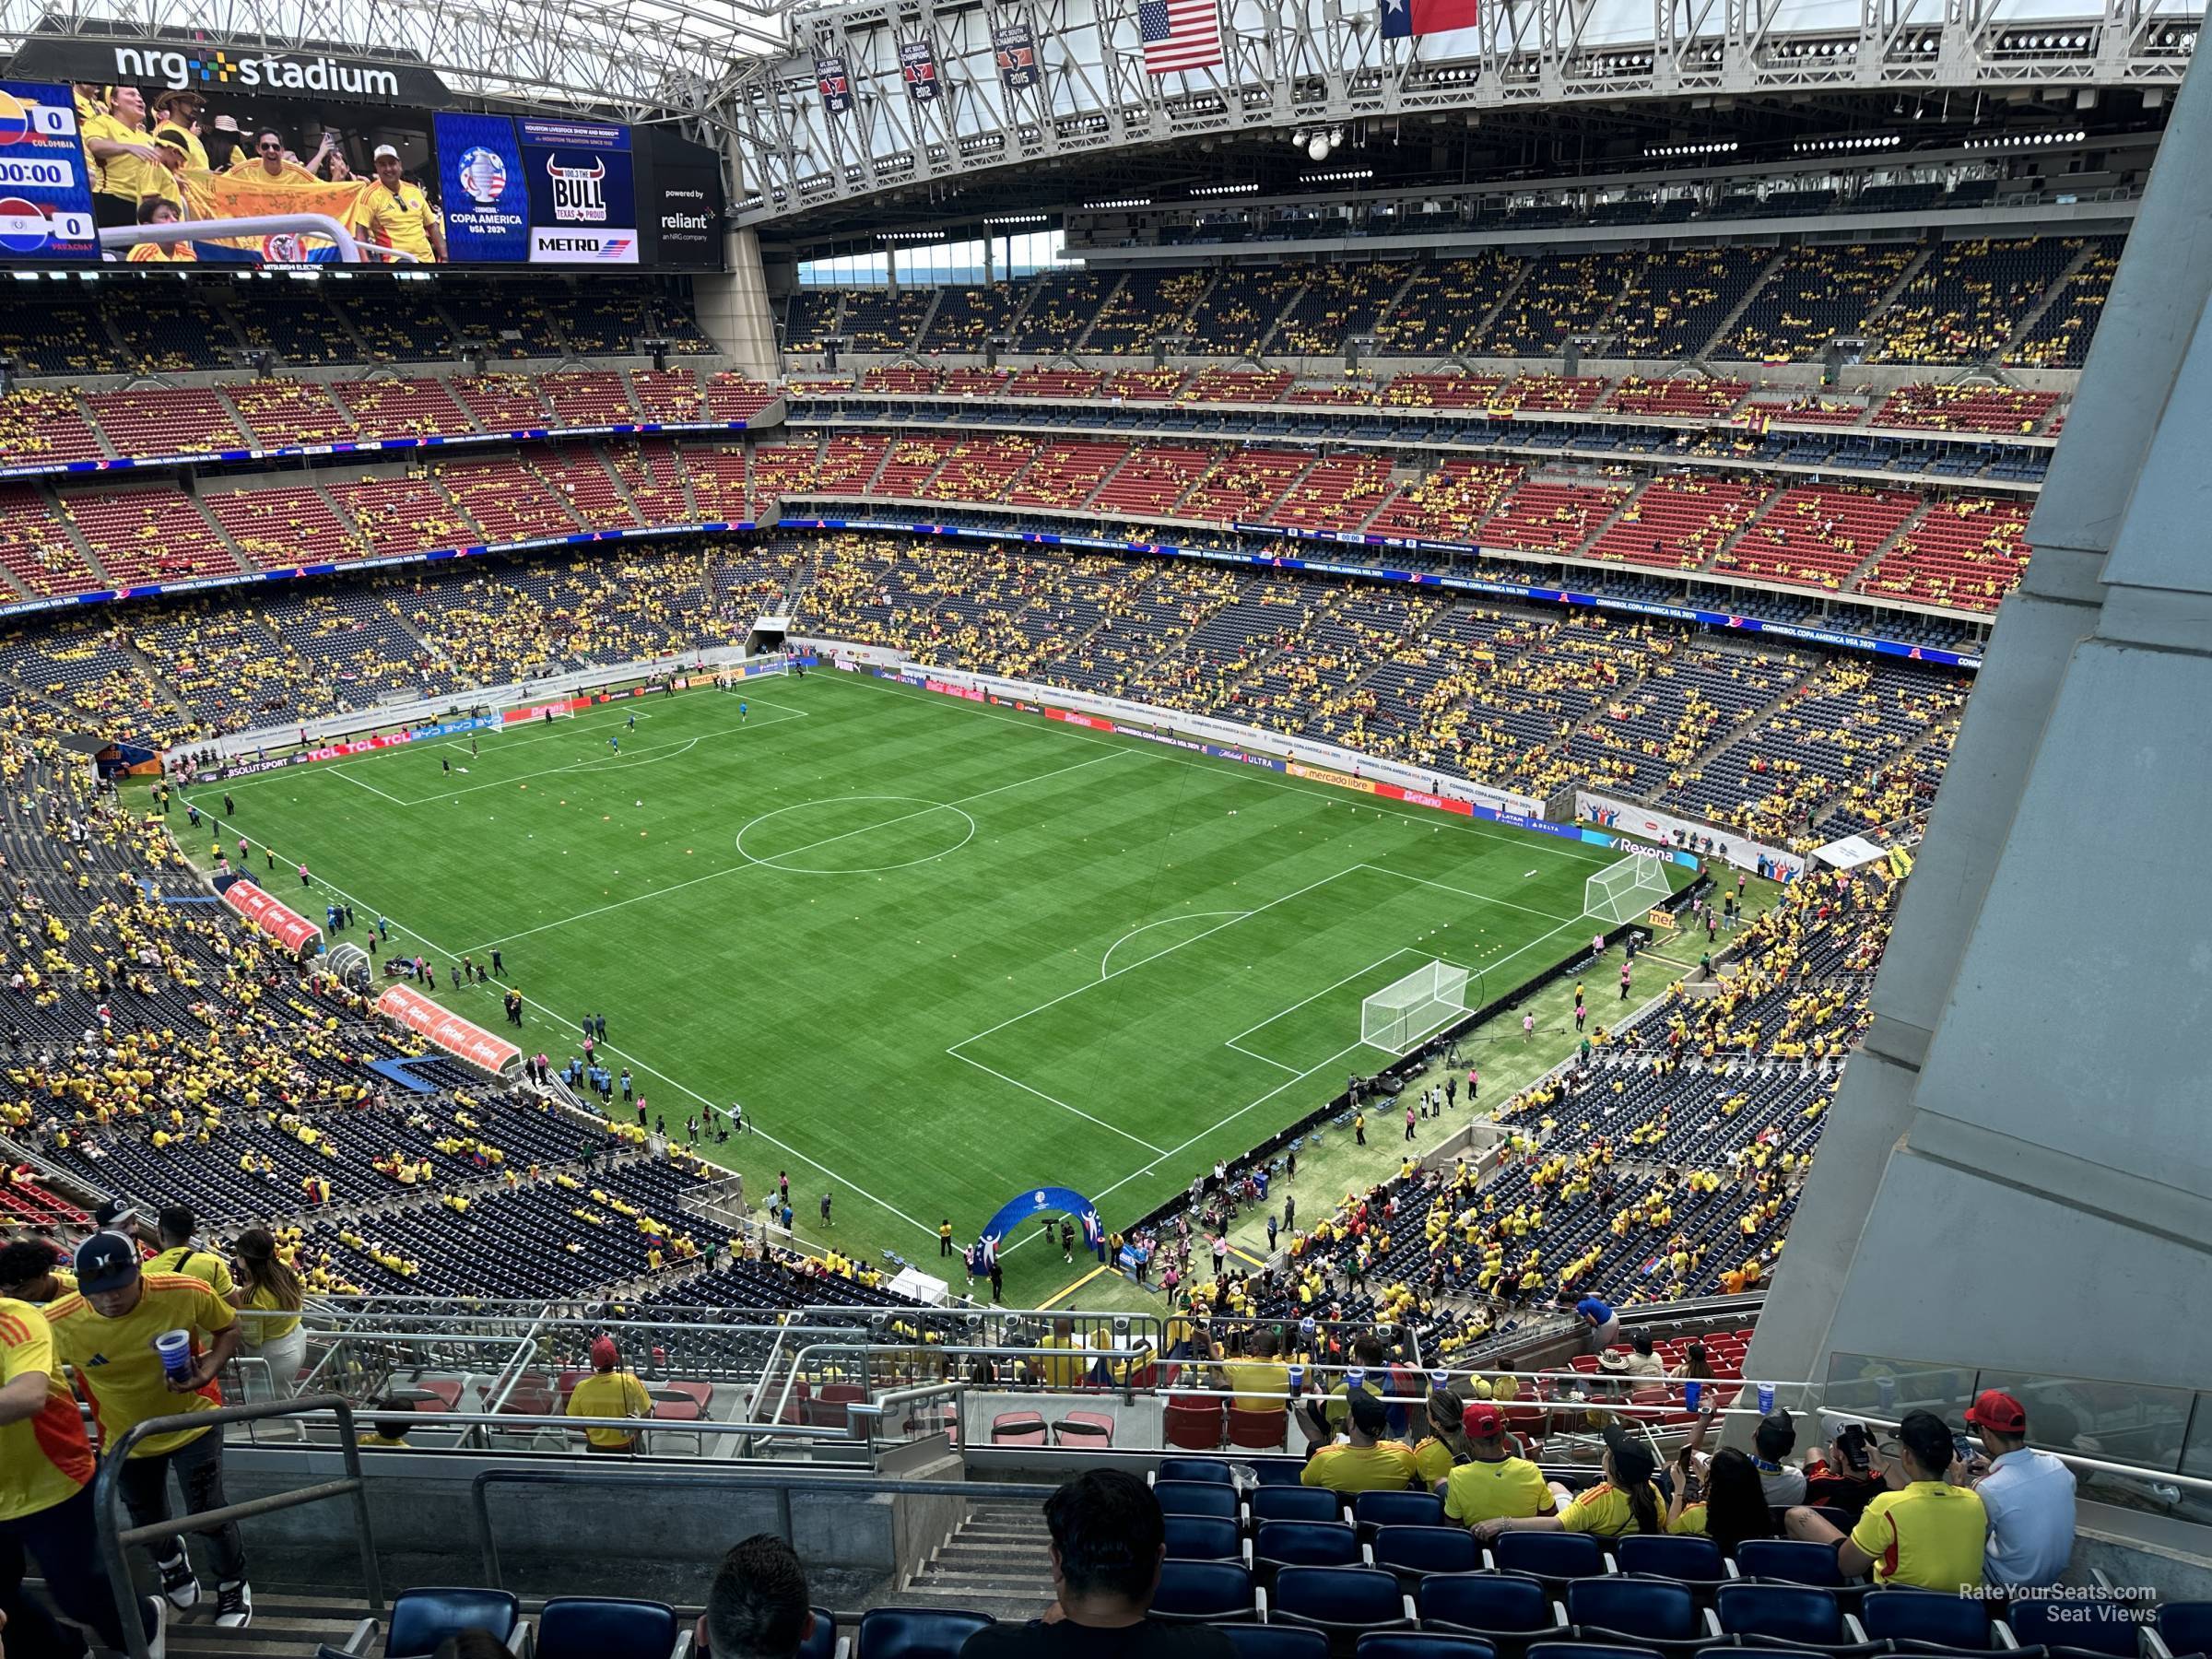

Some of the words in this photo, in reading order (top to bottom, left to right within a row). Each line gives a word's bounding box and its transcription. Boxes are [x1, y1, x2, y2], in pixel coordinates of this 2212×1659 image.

[996, 33, 1029, 46] CHAMPIONS
[903, 50, 930, 62] CHAMPIONS
[114, 47, 189, 89] nrg
[239, 53, 399, 96] stadium
[1009, 72, 1030, 85] 2015
[915, 87, 930, 98] 2012
[831, 100, 844, 110] 2011
[48, 112, 63, 130] 0
[32, 139, 76, 149] COLOMBIA
[579, 171, 588, 179] THE
[555, 179, 605, 208] BULL
[665, 190, 695, 198] powered
[695, 190, 703, 199] by
[451, 214, 477, 223] COPA
[479, 214, 523, 225] AMERICA
[586, 210, 605, 218] PROUD
[661, 212, 708, 229] reliant
[66, 218, 81, 236] 0
[469, 225, 486, 233] USA
[487, 226, 506, 234] 2024
[538, 238, 599, 252] METRO
[160, 582, 195, 593] CONMEBOL
[195, 581, 213, 589] COPA
[213, 577, 241, 586] AMERICA
[5, 606, 21, 614] COPA
[22, 601, 50, 611] AMERICA
[1596, 599, 1628, 608] CONMEBOL
[1642, 605, 1669, 616] AMERICA
[1670, 608, 1682, 617] USA
[1682, 610, 1696, 619] 2024
[1761, 624, 1797, 636] CONMEBOL
[1797, 629, 1814, 639] COPA
[1814, 632, 1844, 643] AMERICA
[1845, 638, 1859, 647] USA
[1859, 640, 1877, 649] 2024
[834, 660, 853, 671] PUMA
[900, 675, 918, 685] ULTRA
[382, 734, 411, 746] TCL
[1118, 726, 1142, 737] CONMEBOL
[1155, 735, 1177, 745] AMERICA
[346, 741, 376, 754] TCL
[310, 748, 341, 761] TCL
[226, 764, 260, 778] BSOLUT
[261, 758, 288, 771] SPORT
[1248, 755, 1272, 768] ULTRA
[1358, 759, 1380, 769] CONMEBOL
[1392, 767, 1411, 777] AMERICA
[1309, 770, 1347, 785] mercado
[1348, 778, 1368, 790] libre
[1403, 791, 1441, 808] Betano
[1449, 782, 1475, 794] CONMEBOL
[1488, 793, 1509, 803] AMERICA
[1520, 801, 1531, 809] 2024
[1502, 814, 1524, 823] LATAM
[1537, 823, 1559, 831] DELTA
[1620, 838, 1674, 863] Rexona
[1648, 912, 1675, 926] mer
